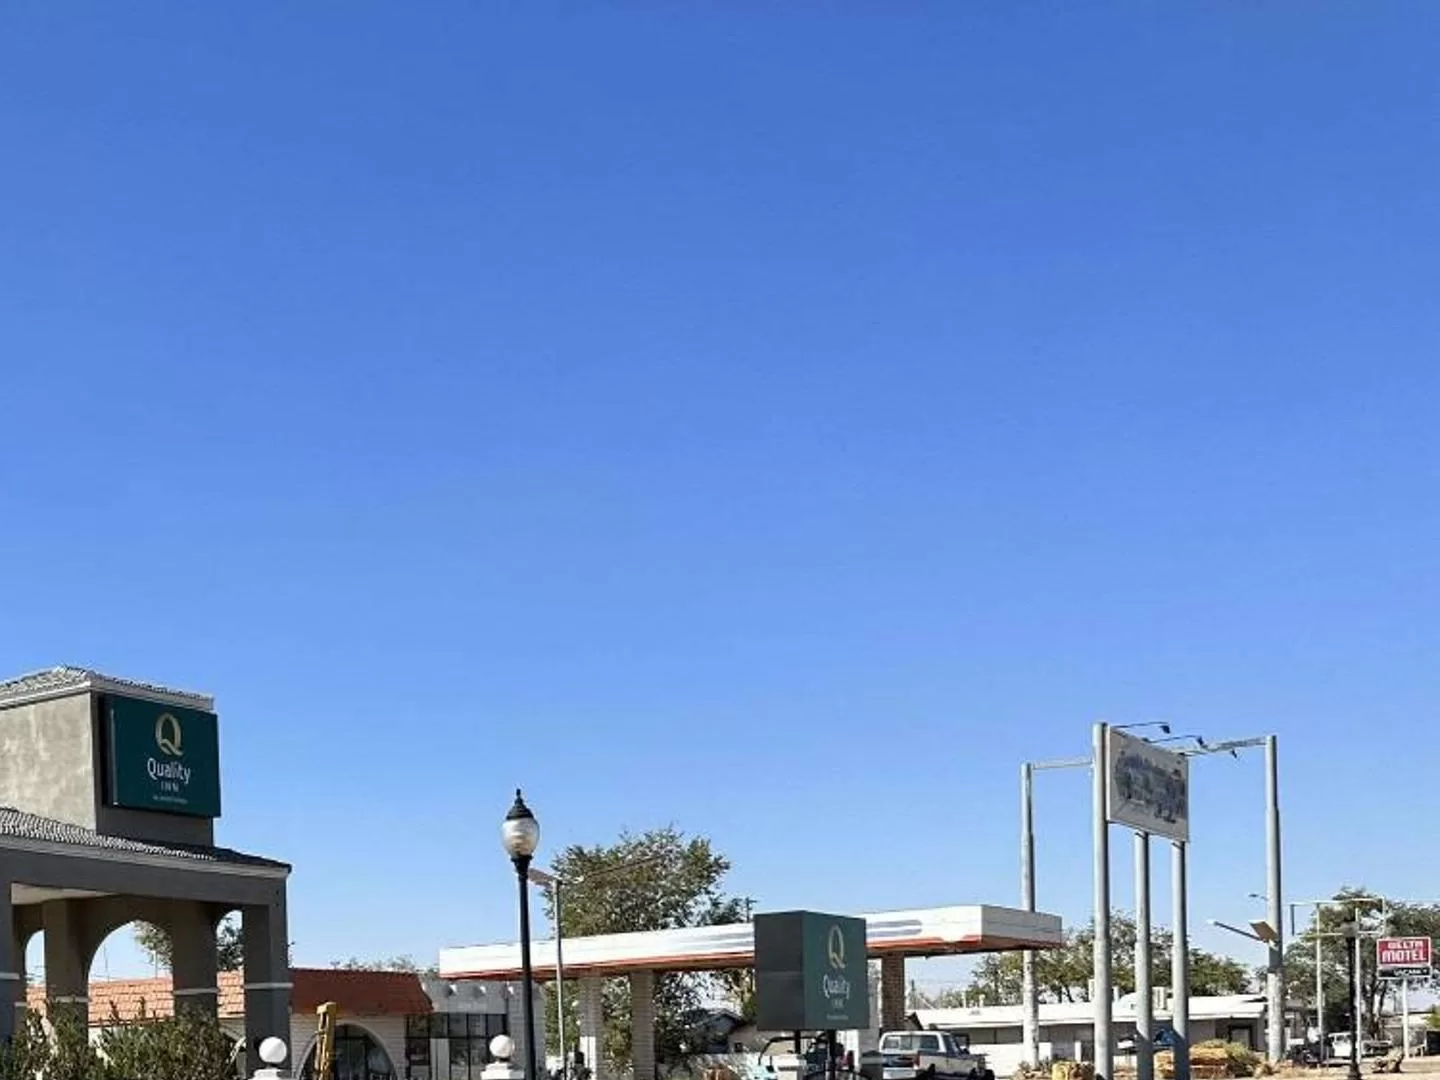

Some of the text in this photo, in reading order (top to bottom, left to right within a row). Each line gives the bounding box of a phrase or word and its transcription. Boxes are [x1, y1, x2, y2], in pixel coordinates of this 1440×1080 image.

[155, 713, 183, 756] Q
[147, 757, 191, 785] Quality
[160, 781, 180, 793] INN
[828, 925, 846, 969] Q
[1382, 950, 1427, 962] MOTEL
